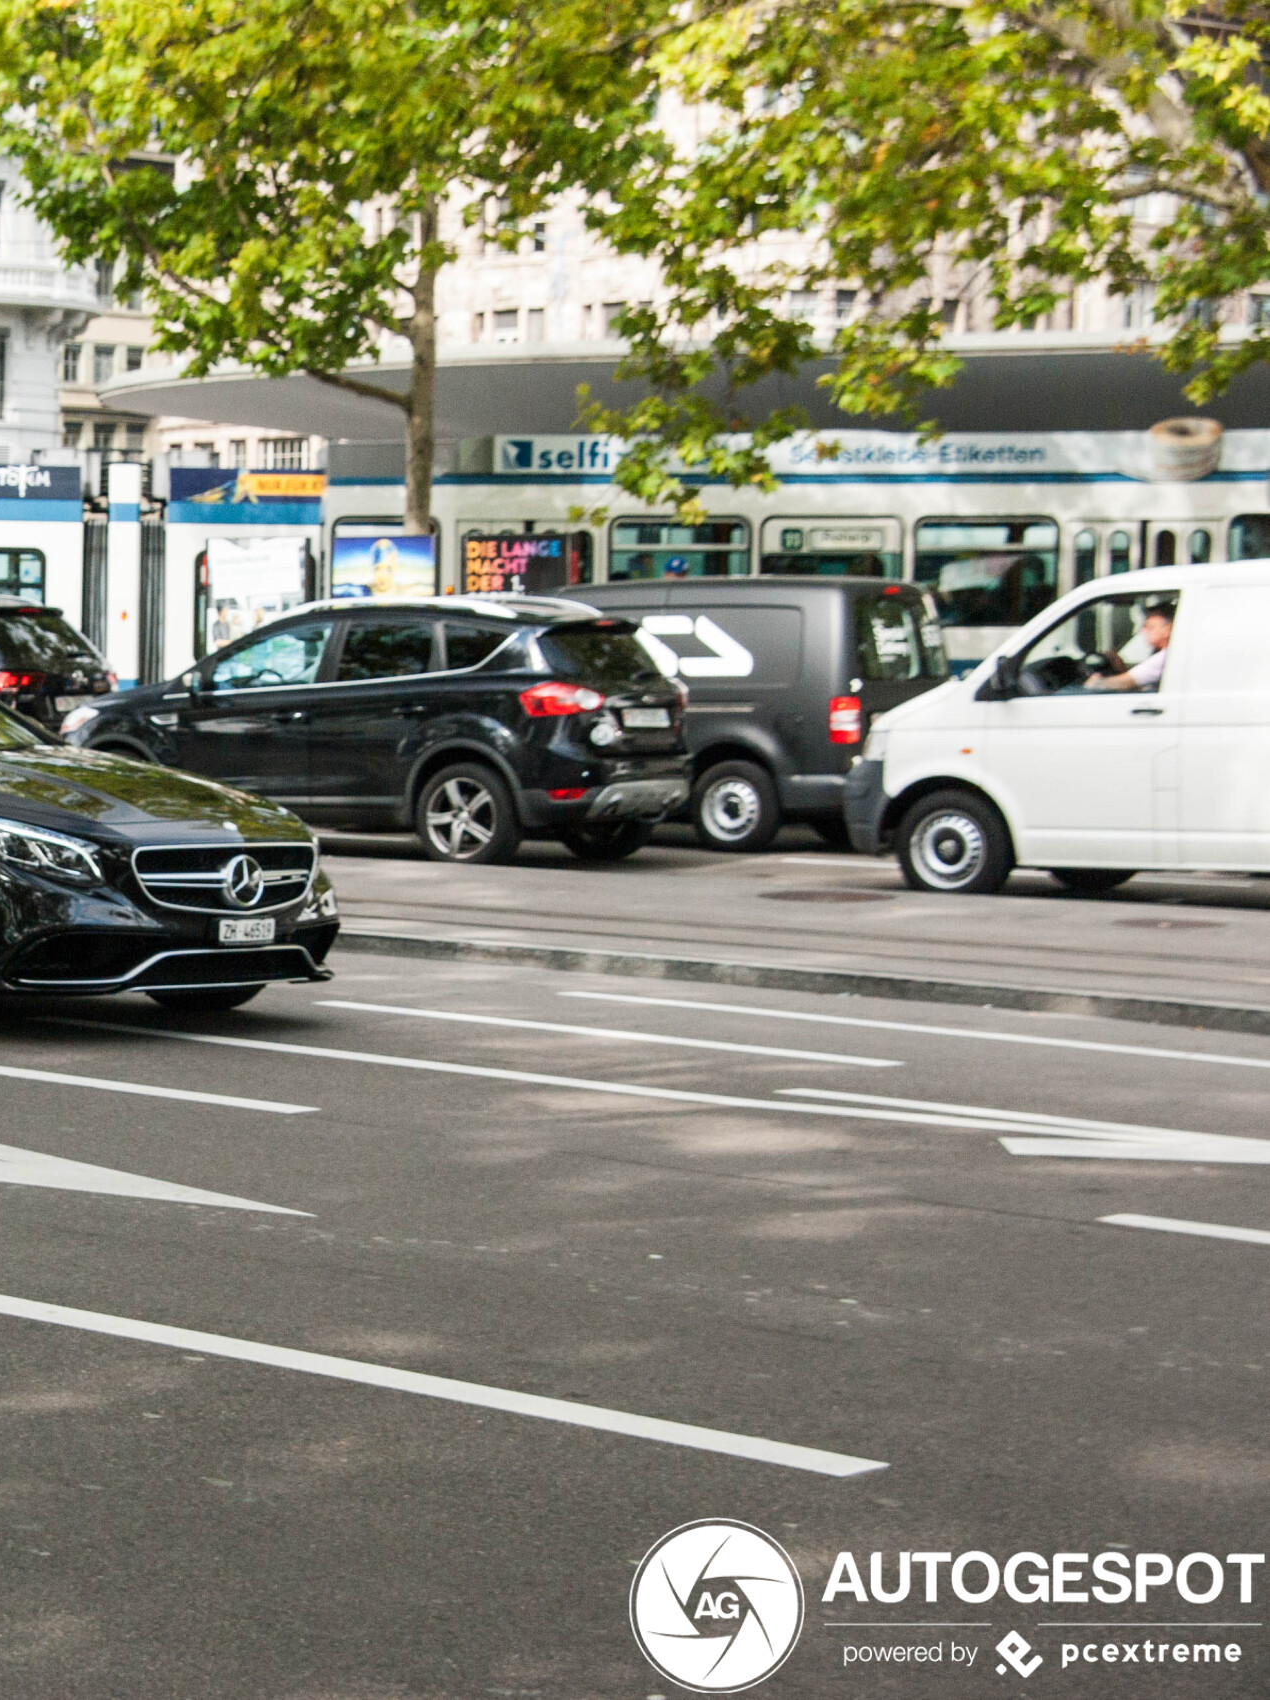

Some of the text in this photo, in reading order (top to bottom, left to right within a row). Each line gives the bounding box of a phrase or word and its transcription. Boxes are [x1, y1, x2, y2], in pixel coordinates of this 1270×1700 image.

[538, 441, 624, 468] selfi
[467, 541, 561, 558] DIE LANGE
[467, 558, 528, 574] NACHT
[467, 574, 504, 591] DER
[224, 924, 237, 939] ZH
